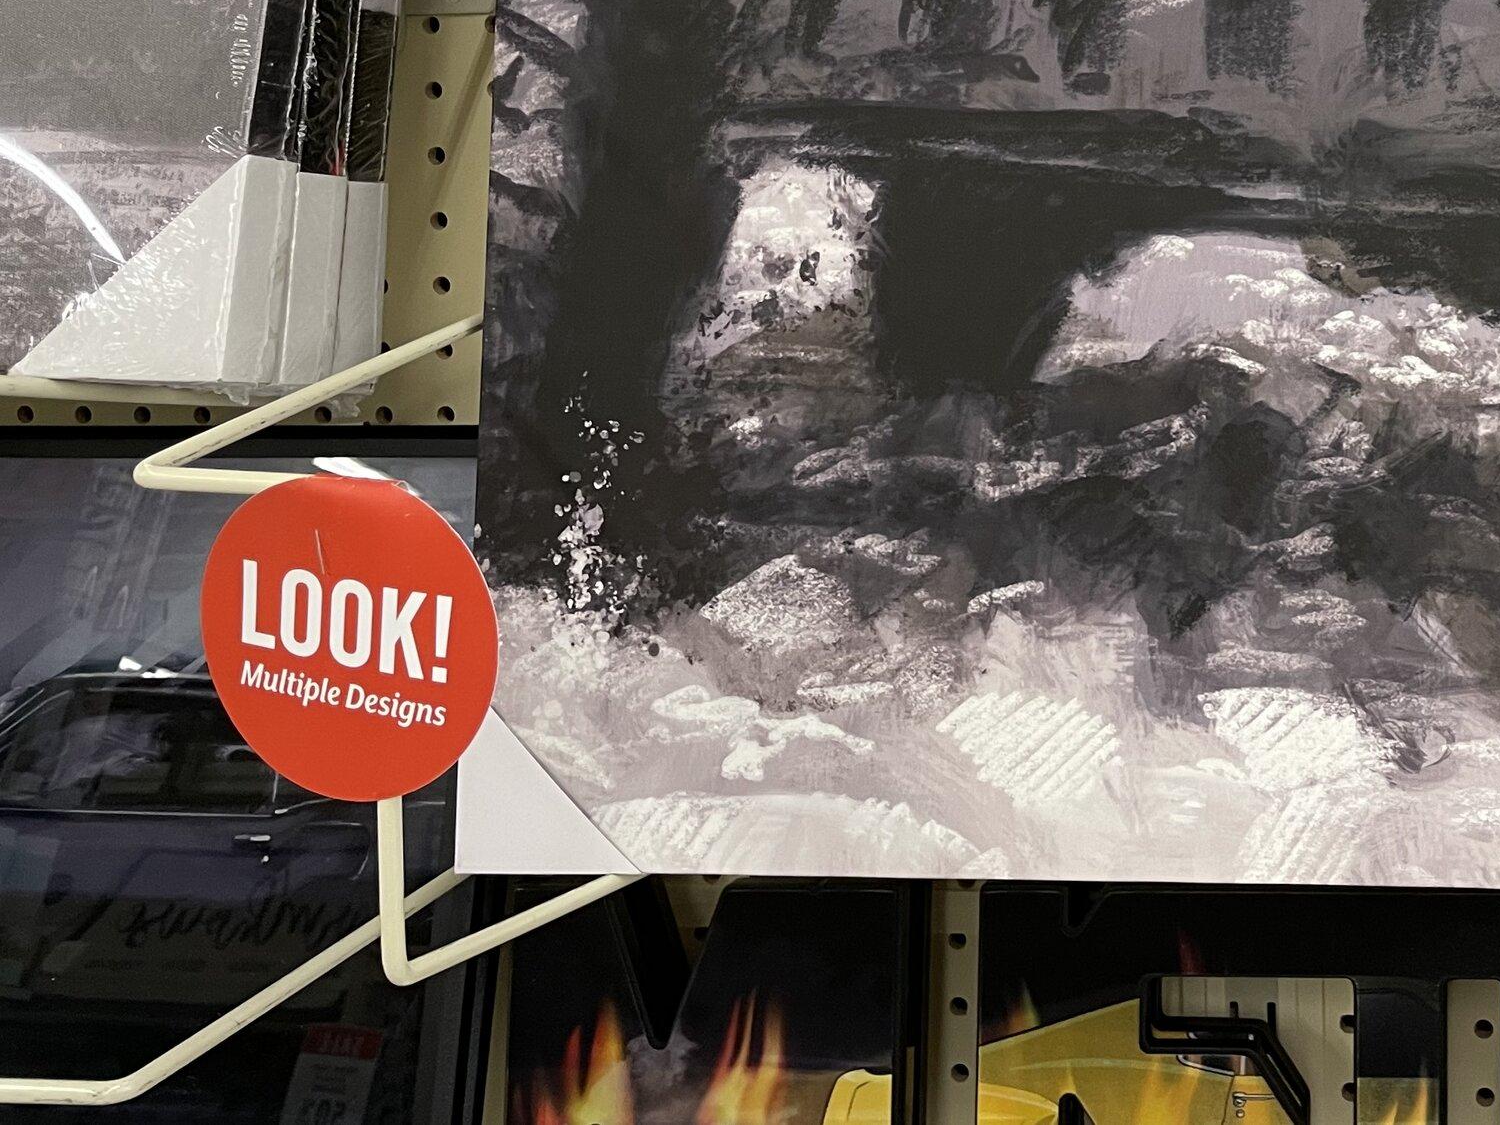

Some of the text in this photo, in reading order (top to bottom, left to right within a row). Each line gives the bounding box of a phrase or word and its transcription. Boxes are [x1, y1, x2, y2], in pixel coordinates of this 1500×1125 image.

[241, 559, 453, 684] LOOK!
[240, 660, 447, 728] Multiple Designs
